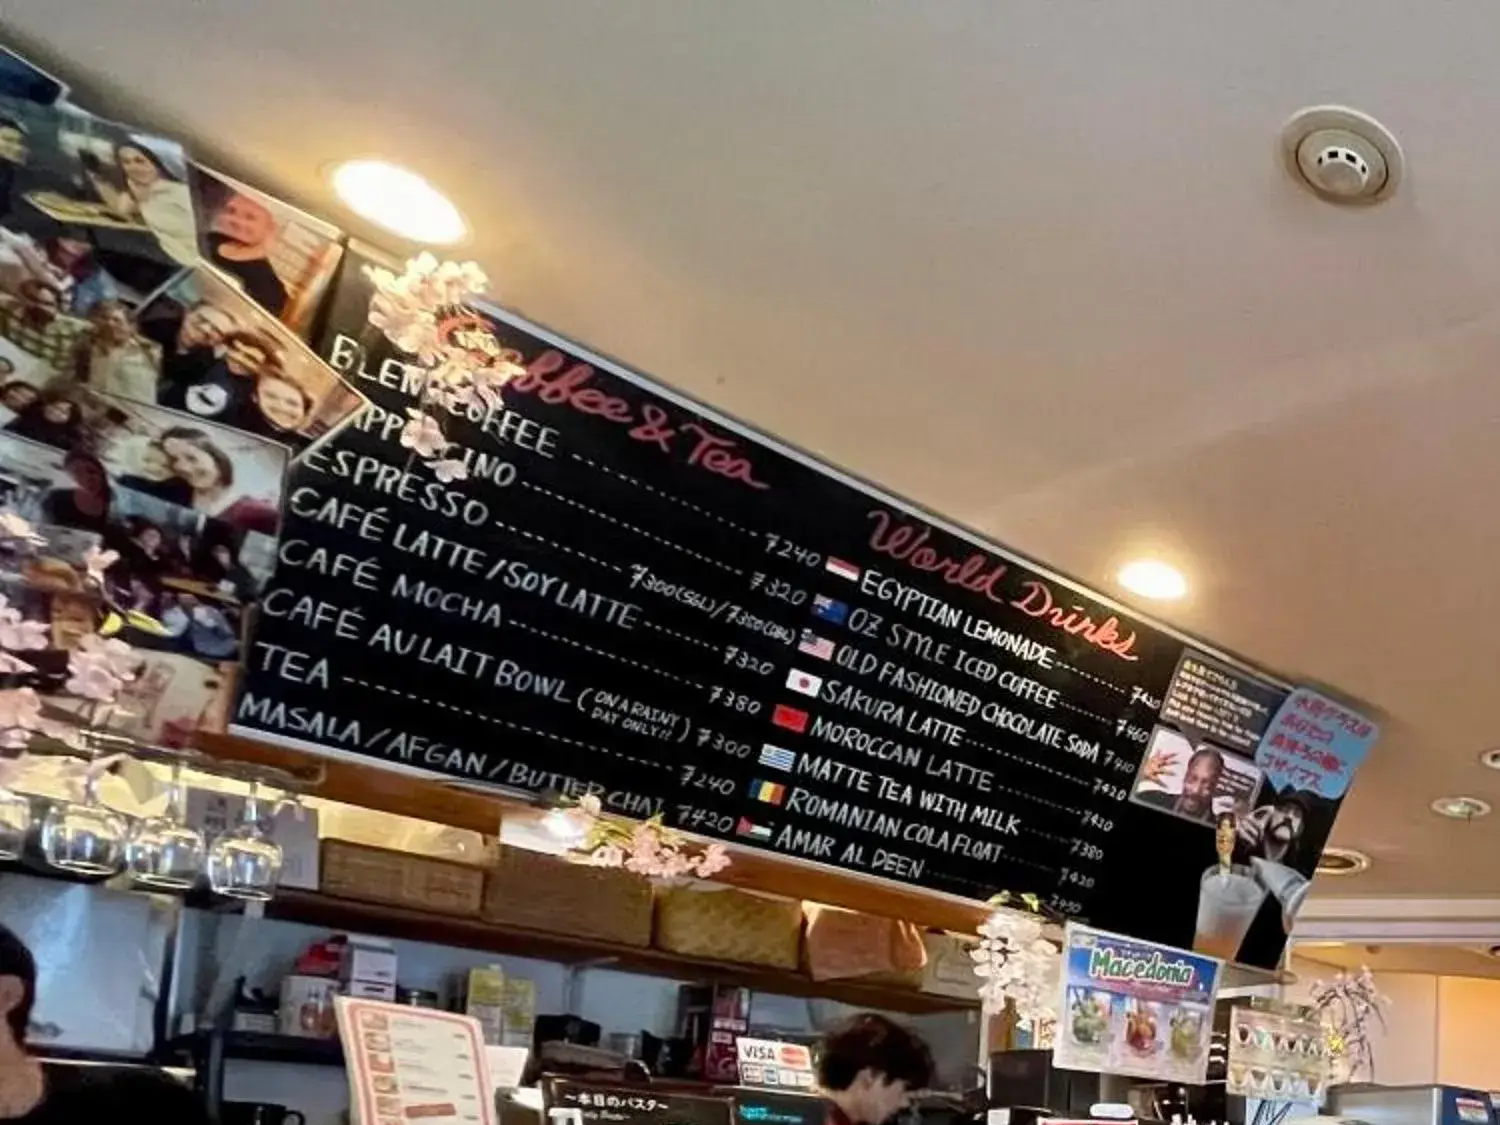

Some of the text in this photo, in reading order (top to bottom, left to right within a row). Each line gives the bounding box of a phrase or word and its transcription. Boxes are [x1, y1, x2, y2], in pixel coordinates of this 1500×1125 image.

[330, 333, 432, 398] BLEN
[449, 396, 560, 459] COFFEE
[302, 442, 490, 527] ESPRESSO
[351, 404, 516, 486] APPINO
[628, 403, 676, 452] &
[679, 422, 771, 489] Tea
[279, 539, 382, 592] CAFÉ
[391, 572, 501, 628] MOCHA
[290, 486, 391, 542] CAFÉ
[555, 581, 643, 630] LATTE
[867, 509, 1139, 661] World Drinks
[262, 587, 571, 703] CAFÉ AU LAIT BOWL
[848, 607, 884, 638] OZ
[885, 622, 951, 665] STYLE
[952, 650, 998, 683] ICED
[998, 670, 1061, 709] COFFEE
[860, 569, 963, 629] EGYPTIAN
[963, 615, 1056, 670] LEMONADE
[256, 641, 329, 689] TEA
[835, 644, 878, 675] OLD
[877, 660, 982, 718] FASHIONED
[981, 701, 1067, 749] CHOCOLATE
[1064, 733, 1100, 765] SODA
[809, 715, 923, 768] MOROCCAN
[925, 754, 995, 793] LATTE
[820, 680, 904, 728] SAKURA
[906, 711, 967, 748] LATTE
[607, 791, 666, 815] CHAI
[785, 786, 902, 838] ROMANIAN
[903, 822, 950, 853] COLA
[951, 833, 1005, 864] FLOAT
[796, 752, 872, 793] MATTE
[877, 775, 913, 807] TEA
[919, 789, 968, 823] WITH
[969, 804, 1022, 836] MILK
[774, 824, 837, 857] AMAR
[839, 842, 866, 866] AL
[871, 848, 926, 879] DEEN
[1089, 946, 1195, 987] Macedonia
[743, 1045, 776, 1061] VISA
